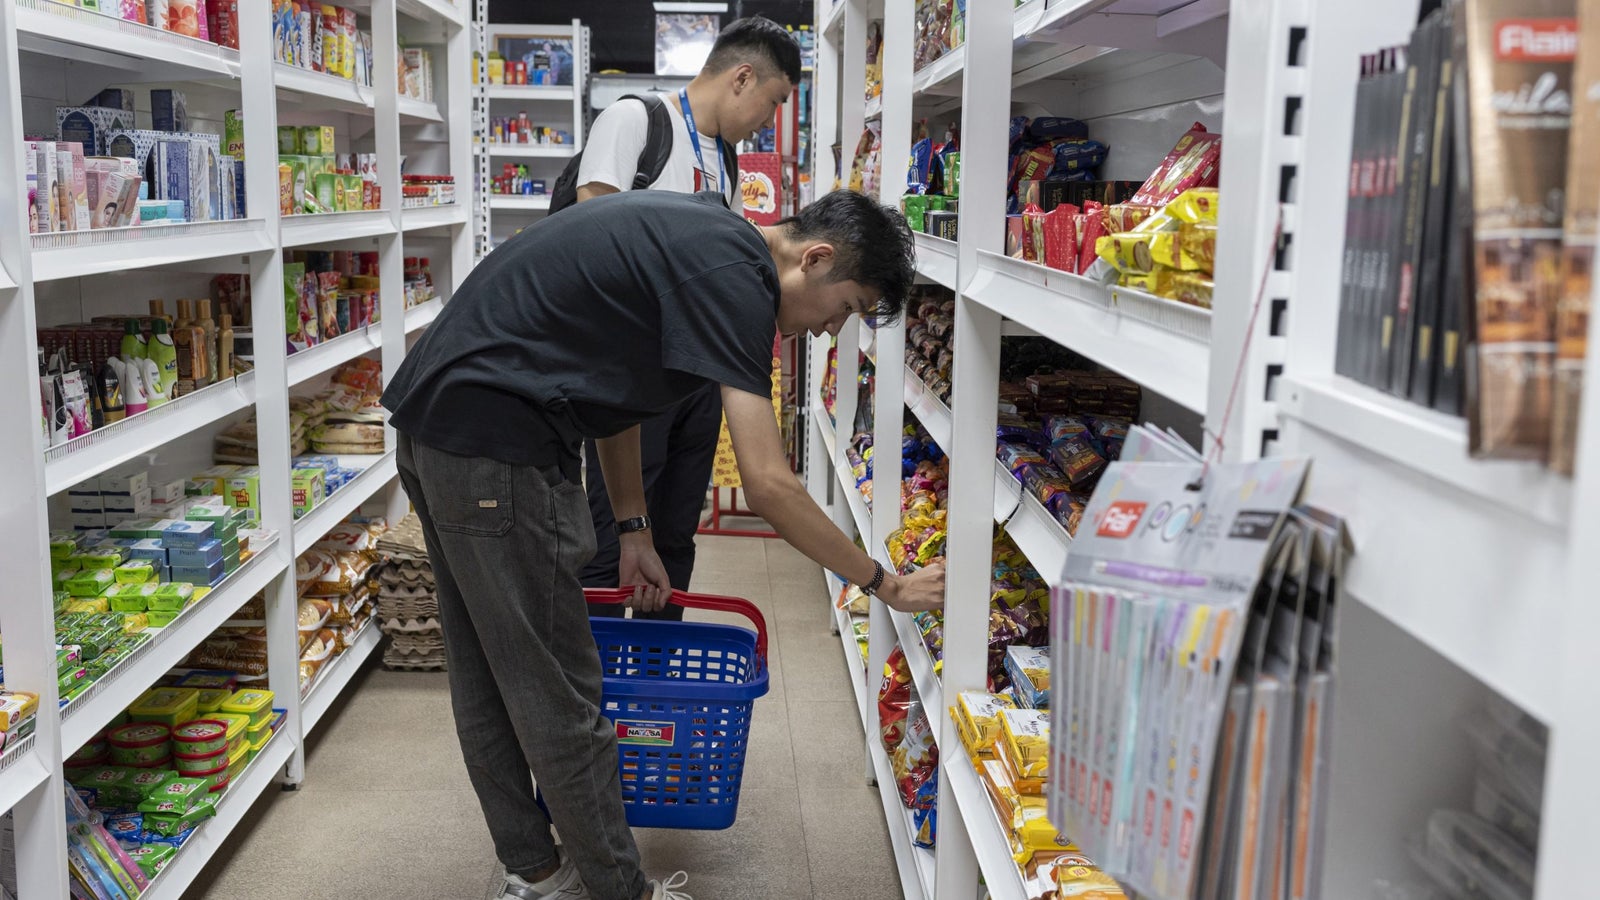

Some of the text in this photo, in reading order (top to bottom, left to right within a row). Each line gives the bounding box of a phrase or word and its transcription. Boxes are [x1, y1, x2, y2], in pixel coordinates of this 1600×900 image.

[311, 15, 324, 66] BOOST
[280, 182, 291, 196] ENO
[1101, 506, 1138, 533] Flair
[248, 661, 265, 671] atta
[628, 729, 661, 737] NAYASA
